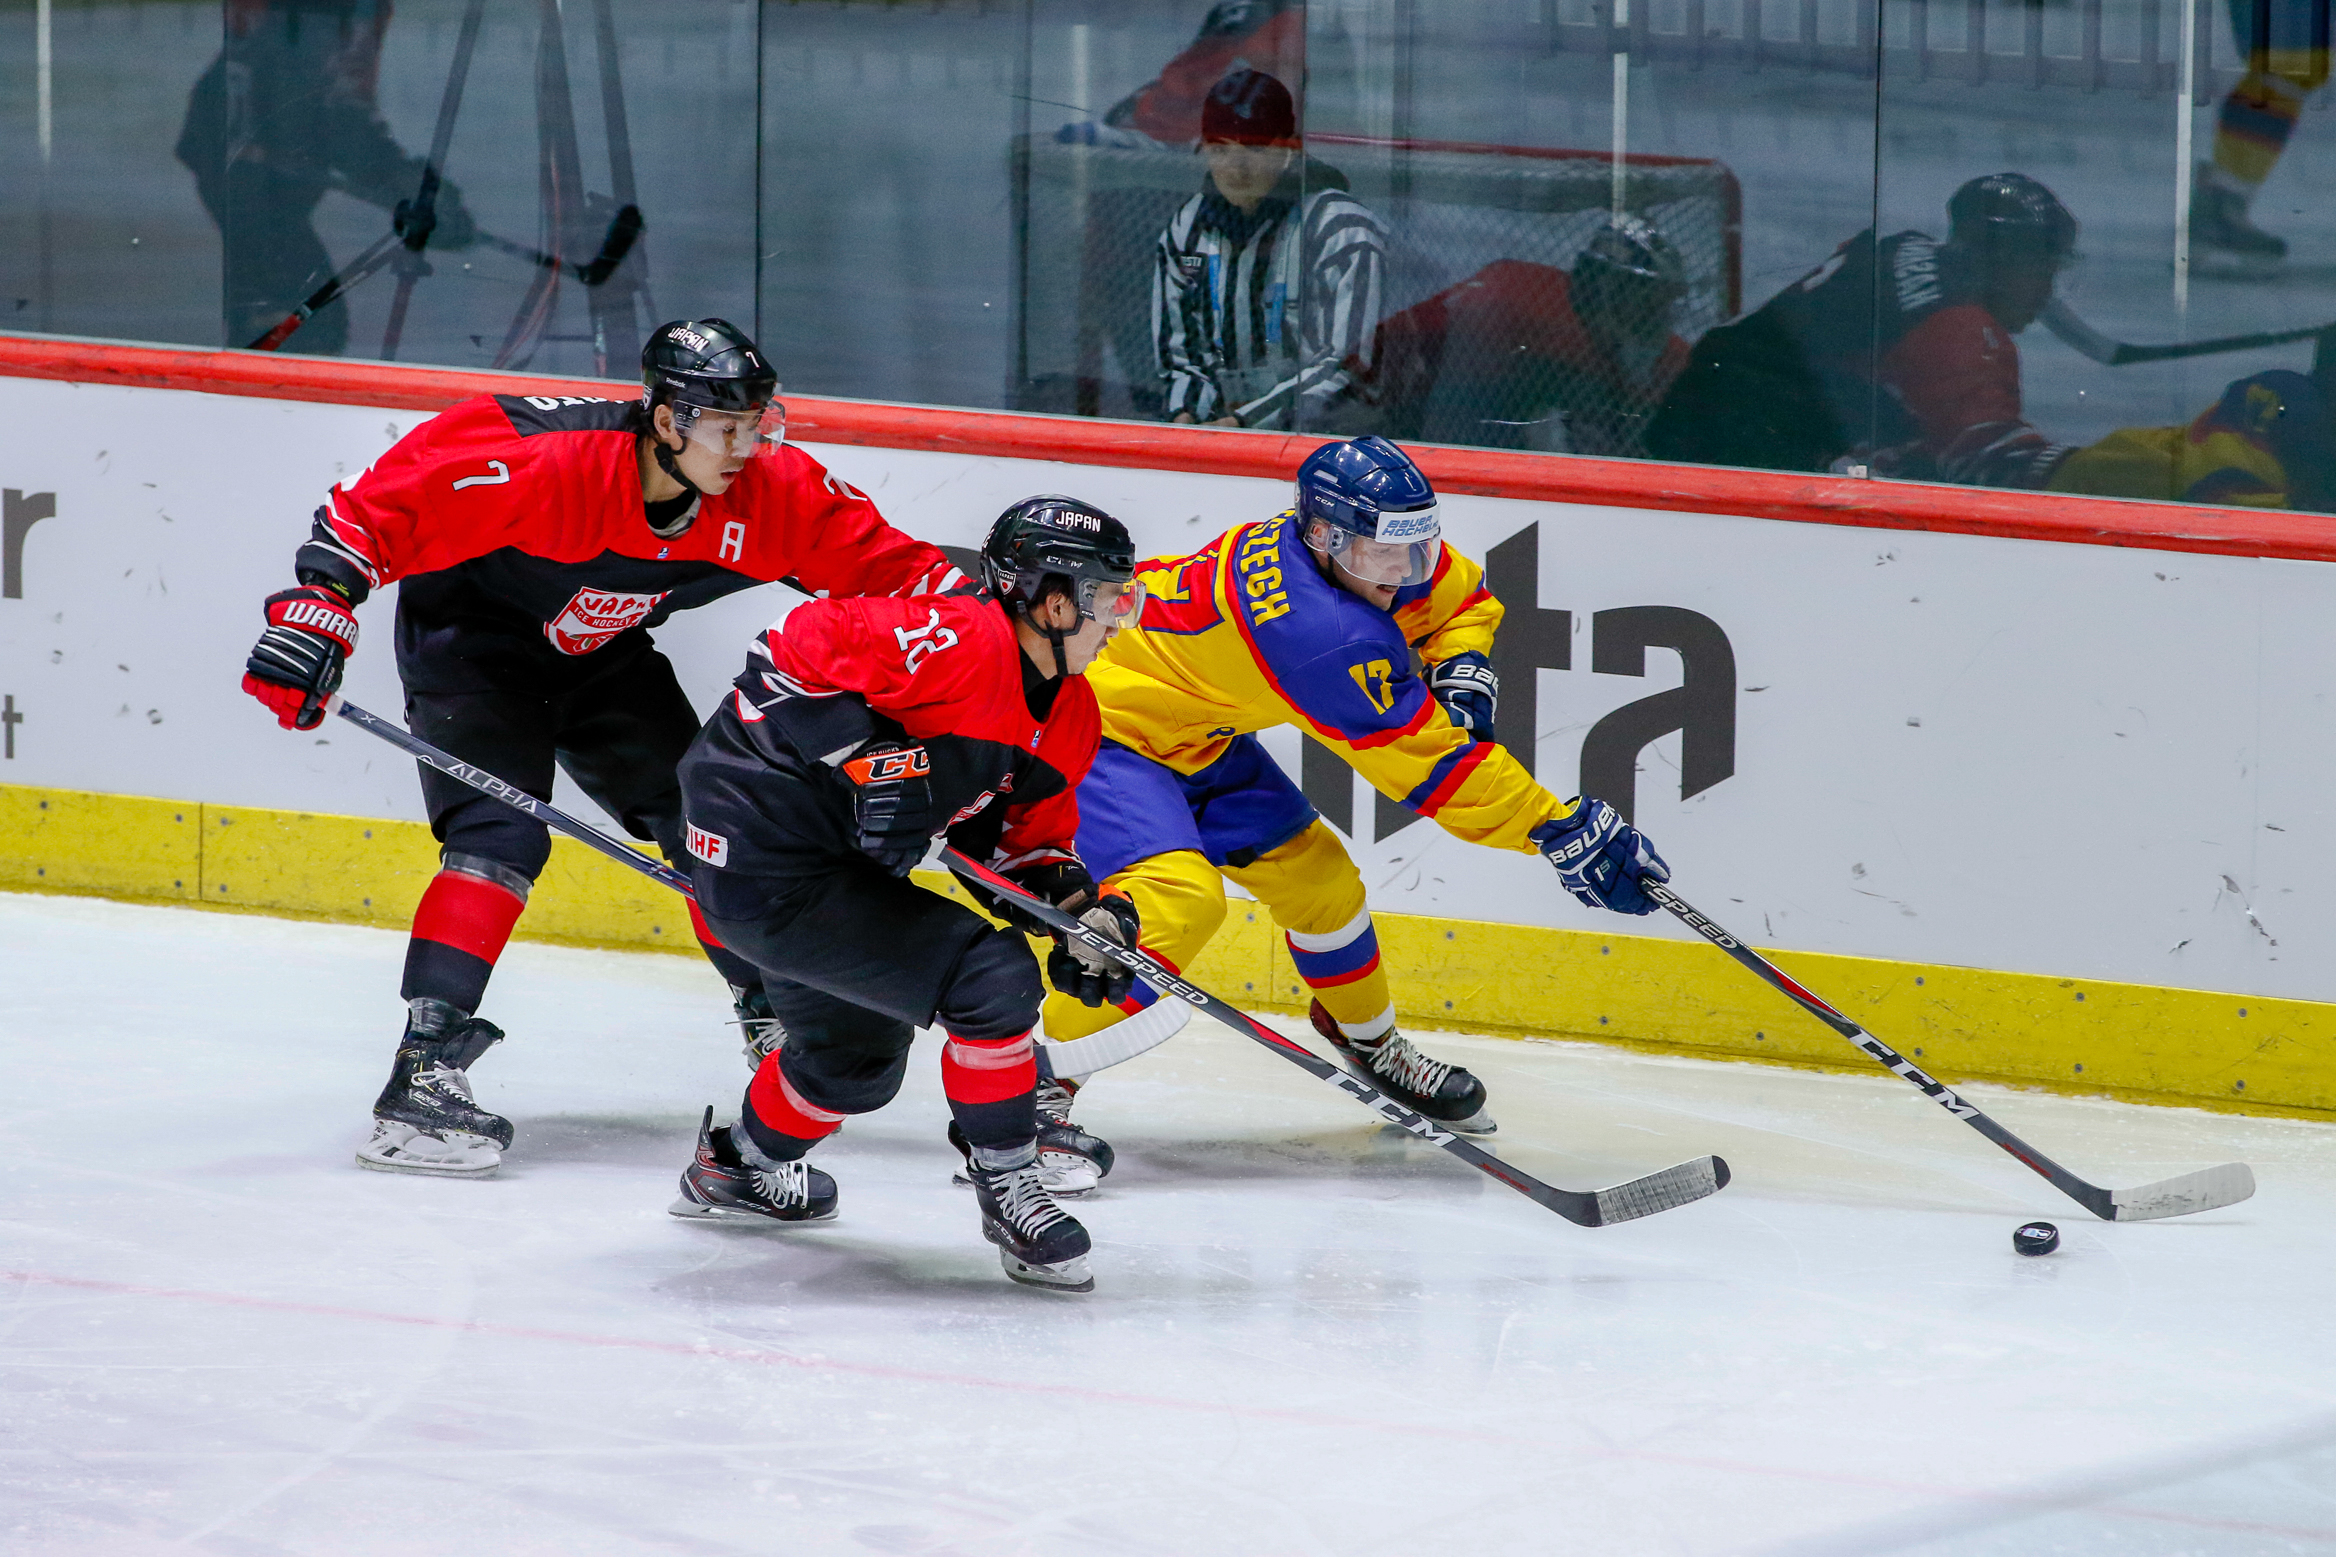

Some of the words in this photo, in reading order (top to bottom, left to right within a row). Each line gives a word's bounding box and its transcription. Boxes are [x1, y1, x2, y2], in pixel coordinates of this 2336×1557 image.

[668, 327, 708, 351] JAPAN
[745, 351, 760, 368] 7
[666, 376, 686, 389] Reebok
[452, 459, 511, 491] 7
[1314, 495, 1335, 508] CCM
[1056, 510, 1101, 533] JAPAN
[718, 519, 746, 563] A
[574, 606, 590, 623] ICE
[591, 616, 632, 628] HOCKEY
[893, 607, 960, 676] 12
[1348, 658, 1395, 716] 17
[446, 762, 538, 815] ALPHA
[1059, 921, 1211, 1006] JETSPEED
[1848, 1028, 1981, 1122] CCM
[1325, 1067, 1458, 1148] CCM
[735, 1198, 773, 1214] CCM
[992, 1219, 1016, 1246] CCM
